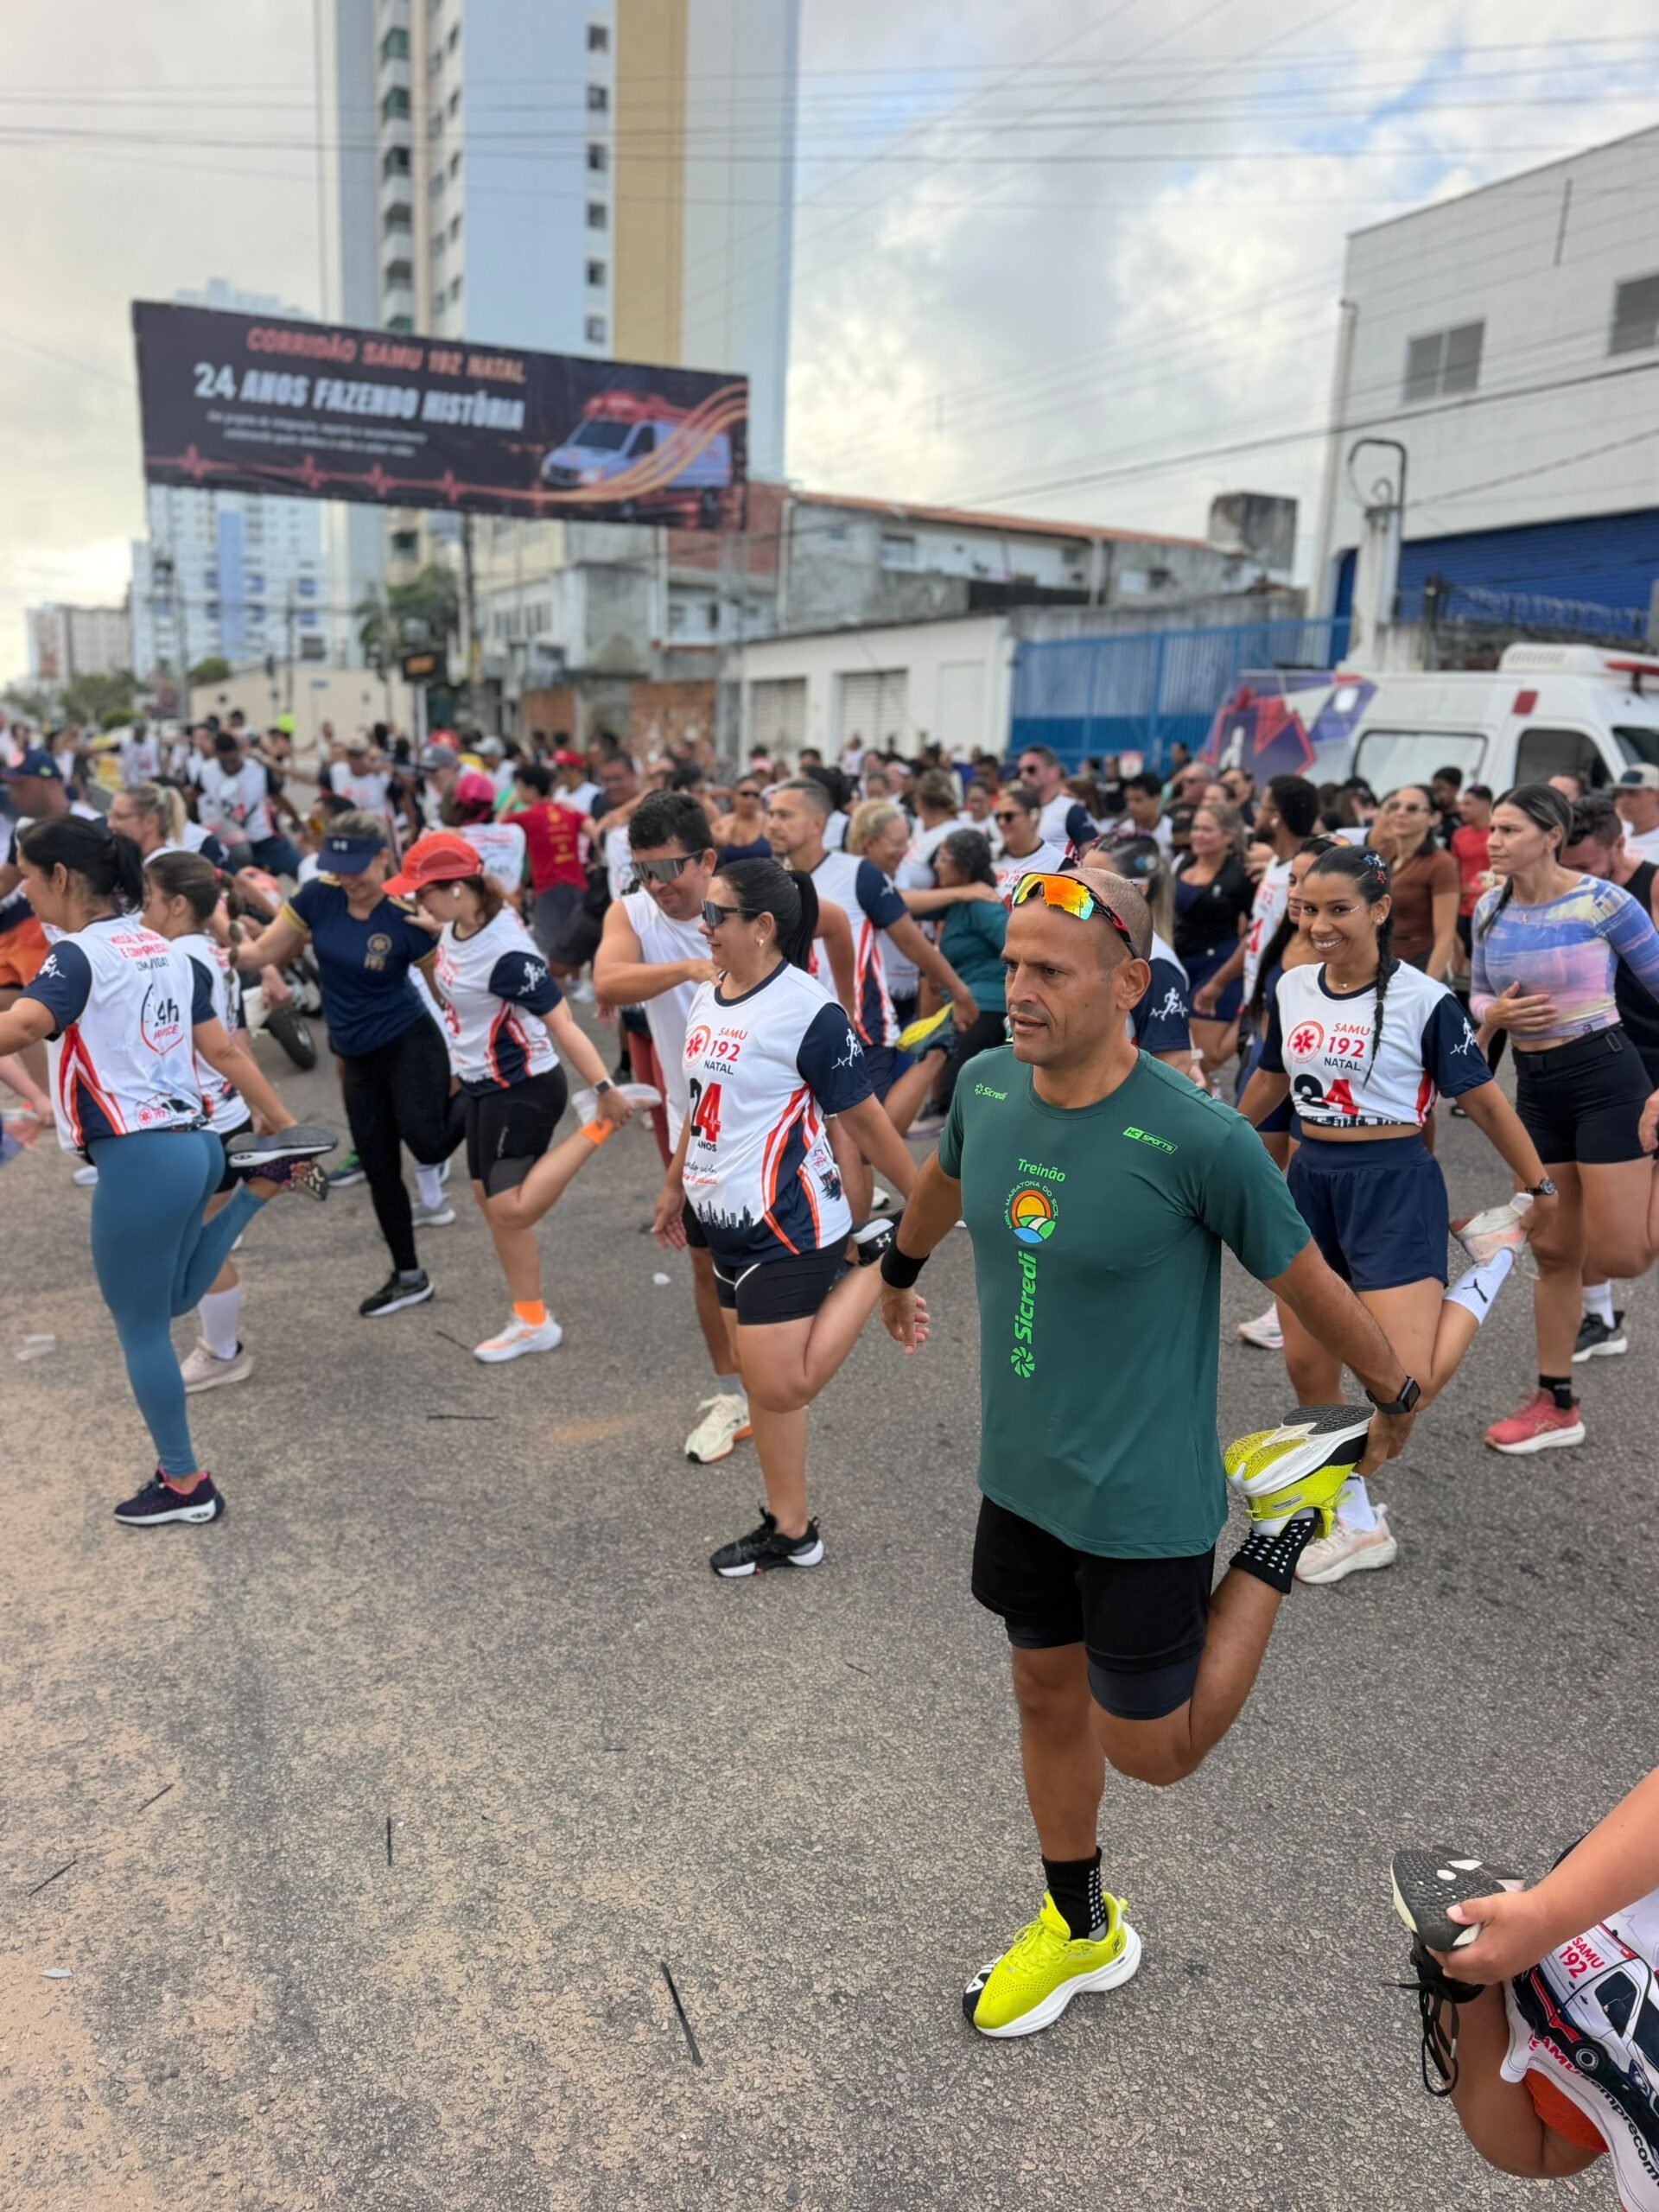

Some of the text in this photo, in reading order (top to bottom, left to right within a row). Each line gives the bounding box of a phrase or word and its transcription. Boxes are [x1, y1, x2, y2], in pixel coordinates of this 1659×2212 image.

[246, 325, 527, 384] CORRIDÃO SAMU 192 NATAL
[194, 361, 237, 401] 24
[239, 368, 310, 408] ANOS
[312, 377, 420, 419] FAZENDO
[421, 389, 525, 431] HISTÓRIA
[718, 1027, 748, 1041] SAMU
[1333, 1022, 1371, 1036] SAMU
[709, 1039, 741, 1063] 192
[1327, 1036, 1365, 1058] 192
[704, 1059, 734, 1076] NATAL
[1324, 1057, 1362, 1071] NATAL
[982, 1086, 1008, 1101] Sicredi
[690, 1077, 722, 1143] 24
[1126, 1128, 1174, 1152] HC SPORTS
[1018, 1158, 1066, 1182] Treinão
[1005, 1180, 1040, 1206] MARATONA
[1042, 1185, 1052, 1197] DO
[1051, 1198, 1059, 1219] SOL
[1014, 1250, 1037, 1344] Sicredi
[1558, 1945, 1588, 1979] 192
[1572, 1936, 1605, 1969] SAMU
